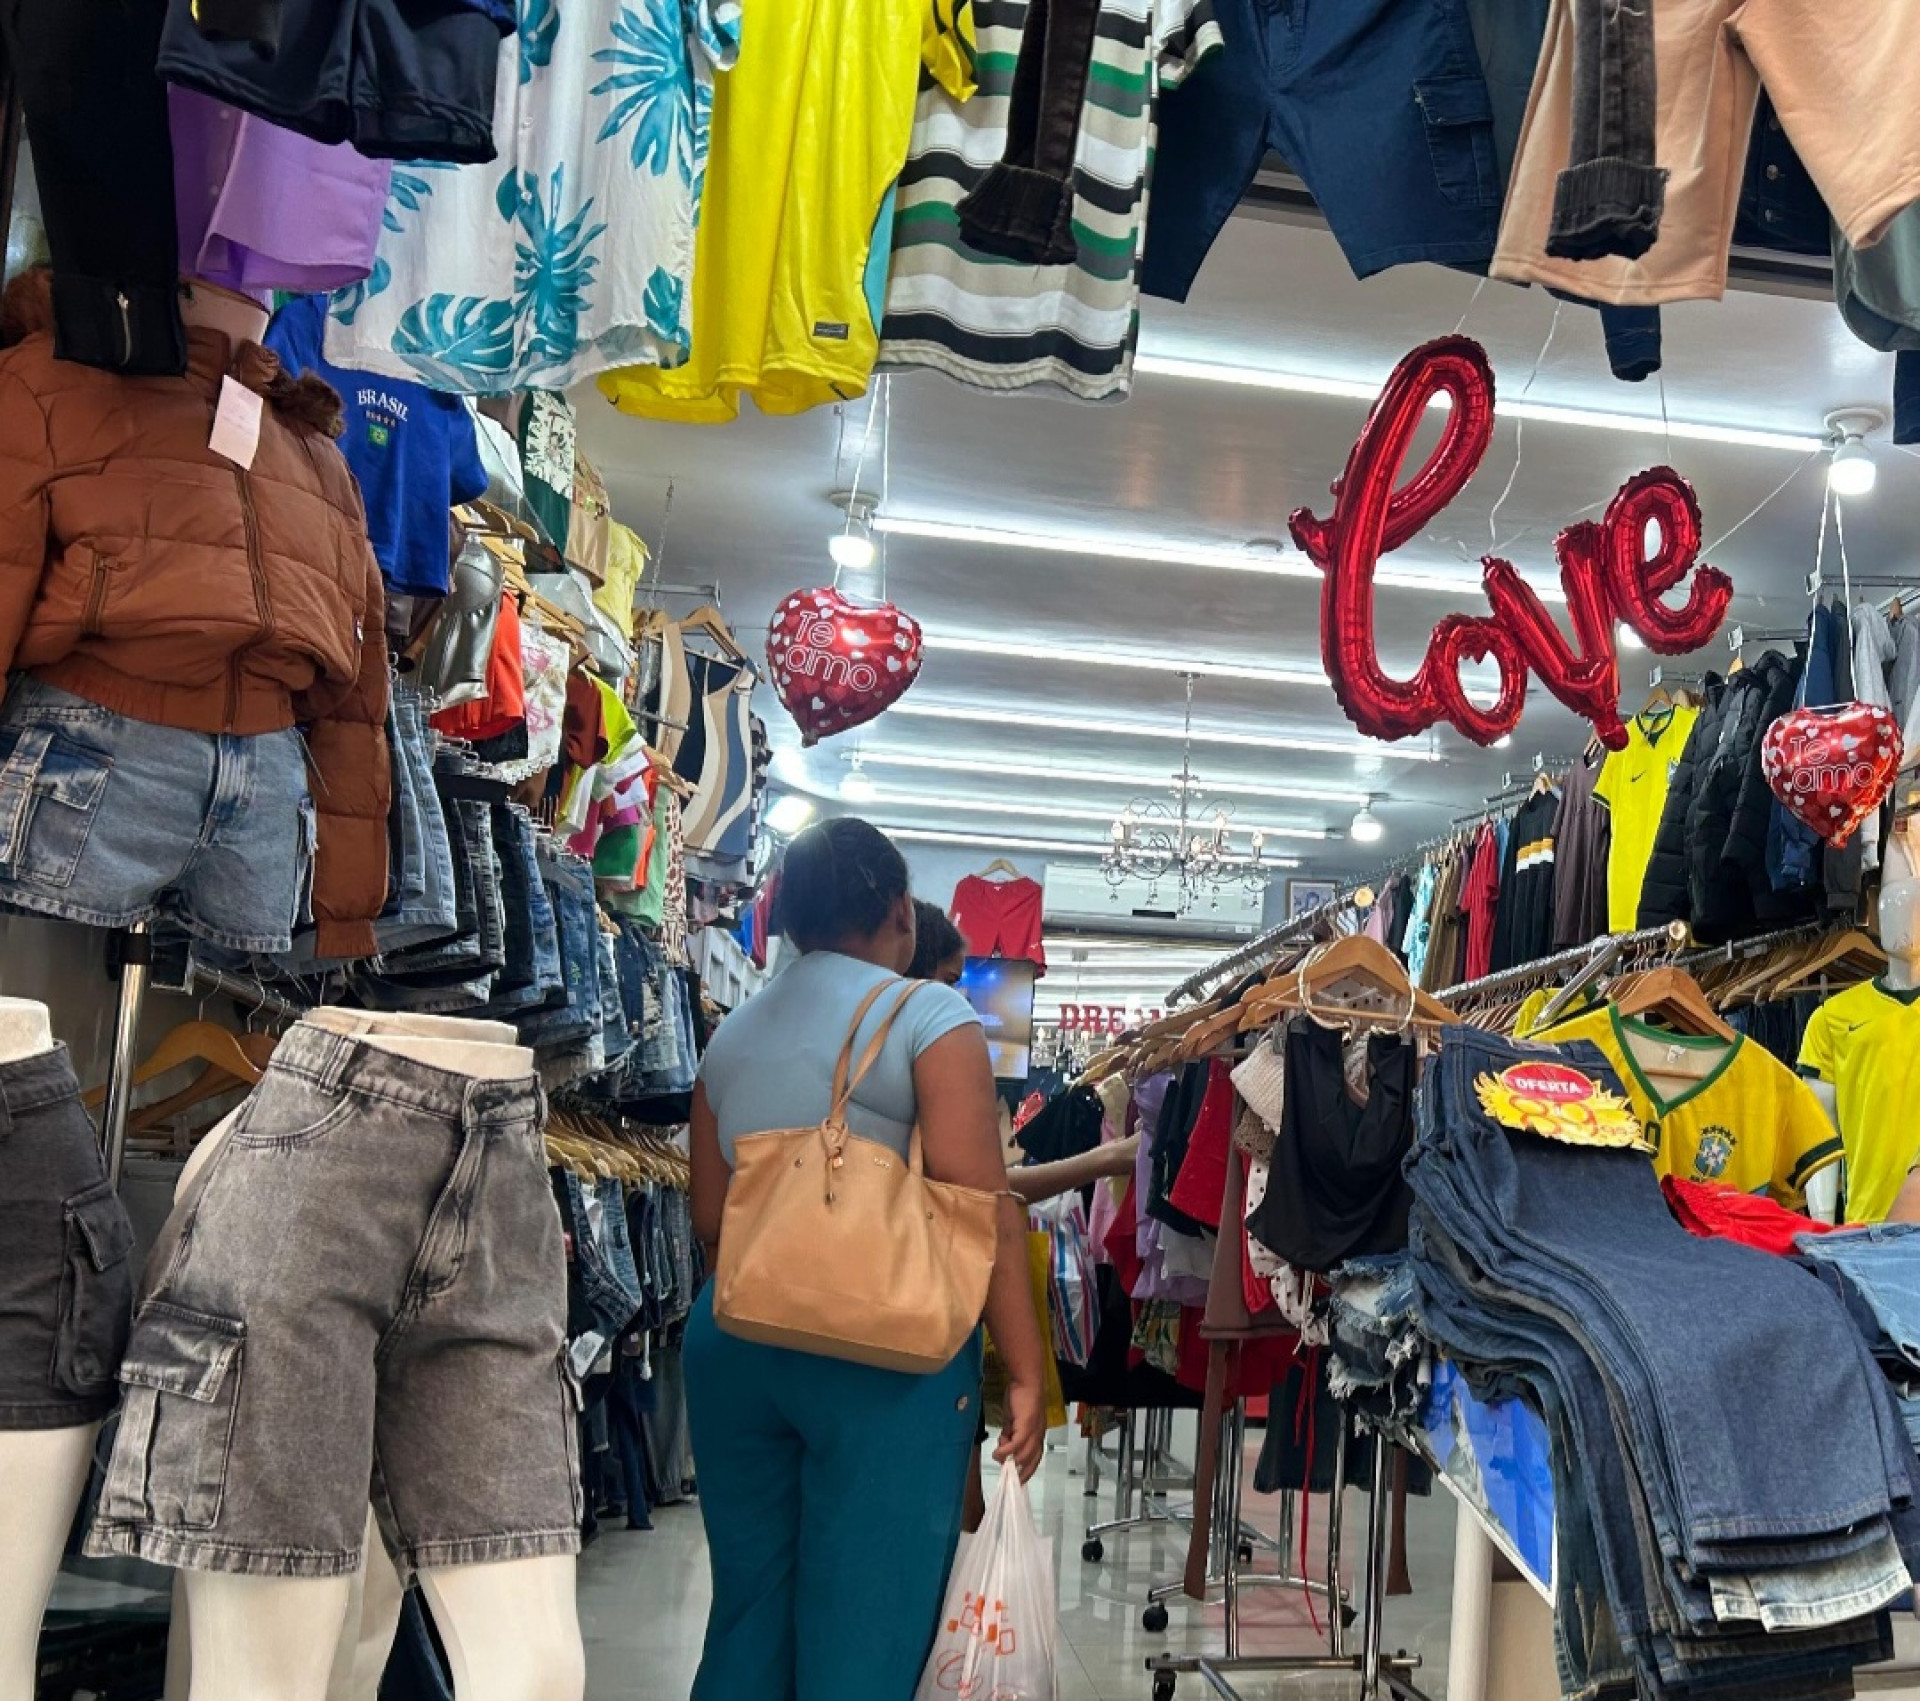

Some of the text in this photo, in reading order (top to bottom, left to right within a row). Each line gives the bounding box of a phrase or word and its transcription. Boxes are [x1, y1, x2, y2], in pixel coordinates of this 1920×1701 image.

[356, 389, 408, 422] BRASIL
[795, 611, 836, 648] Te
[785, 644, 877, 692] amo
[1789, 736, 1830, 766] Te
[1792, 761, 1876, 793] amo
[1514, 1077, 1583, 1094] OFERTA
